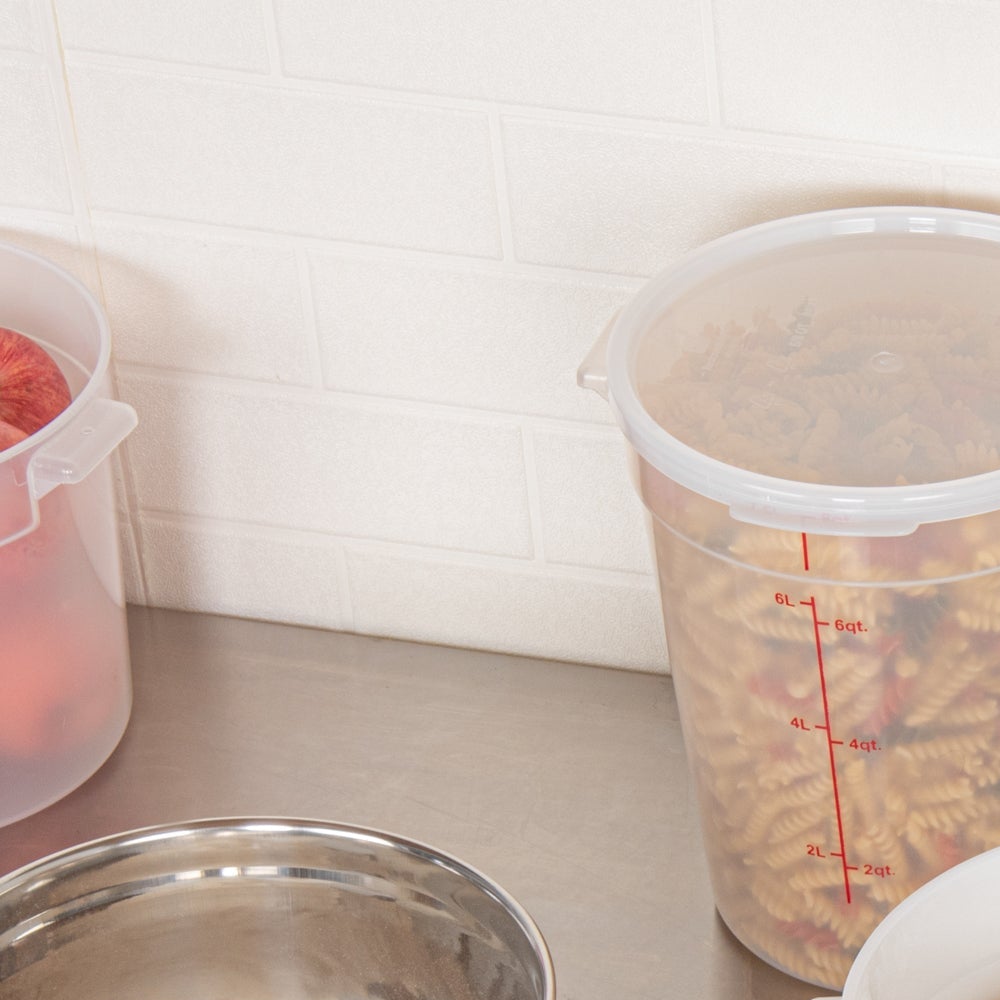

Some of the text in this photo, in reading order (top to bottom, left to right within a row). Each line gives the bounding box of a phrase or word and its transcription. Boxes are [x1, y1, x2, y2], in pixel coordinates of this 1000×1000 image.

[774, 592, 795, 607] 6L
[834, 618, 868, 635] 6qt.
[790, 717, 810, 731] 4L
[849, 738, 882, 752] 4qt.
[806, 844, 826, 858] 2L
[864, 863, 896, 878] 2qt.
